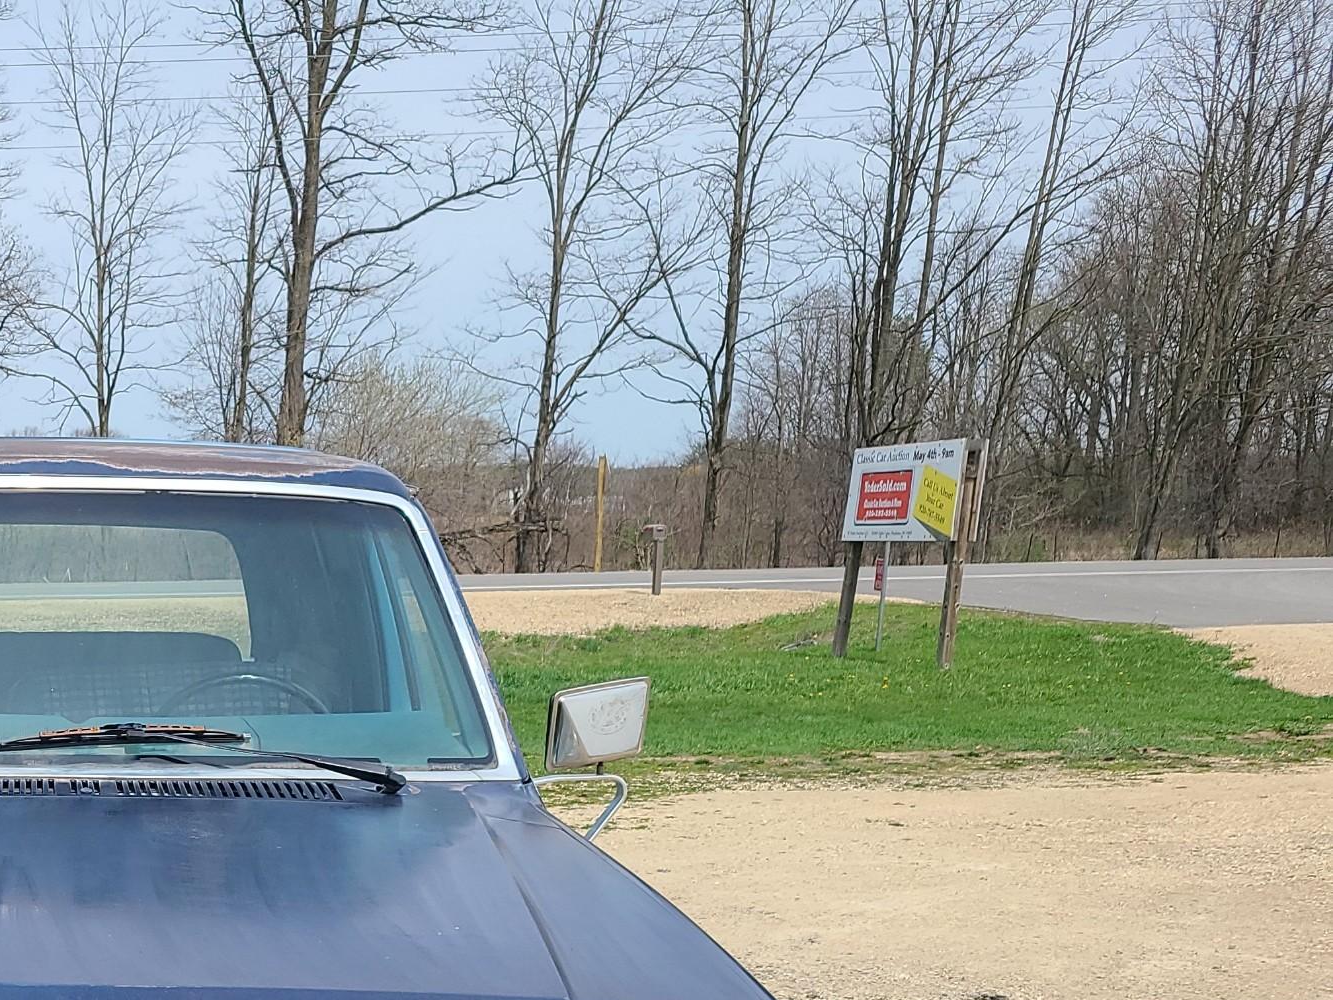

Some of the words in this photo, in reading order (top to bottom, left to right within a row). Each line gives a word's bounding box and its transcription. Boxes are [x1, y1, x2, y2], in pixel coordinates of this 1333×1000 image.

[857, 451, 875, 464] Classic
[876, 452, 886, 463] Car
[887, 450, 910, 462] Auction
[913, 450, 926, 464] May
[927, 448, 937, 460] 4th
[941, 447, 955, 459] 9am
[864, 479, 907, 494] YoderSold.com
